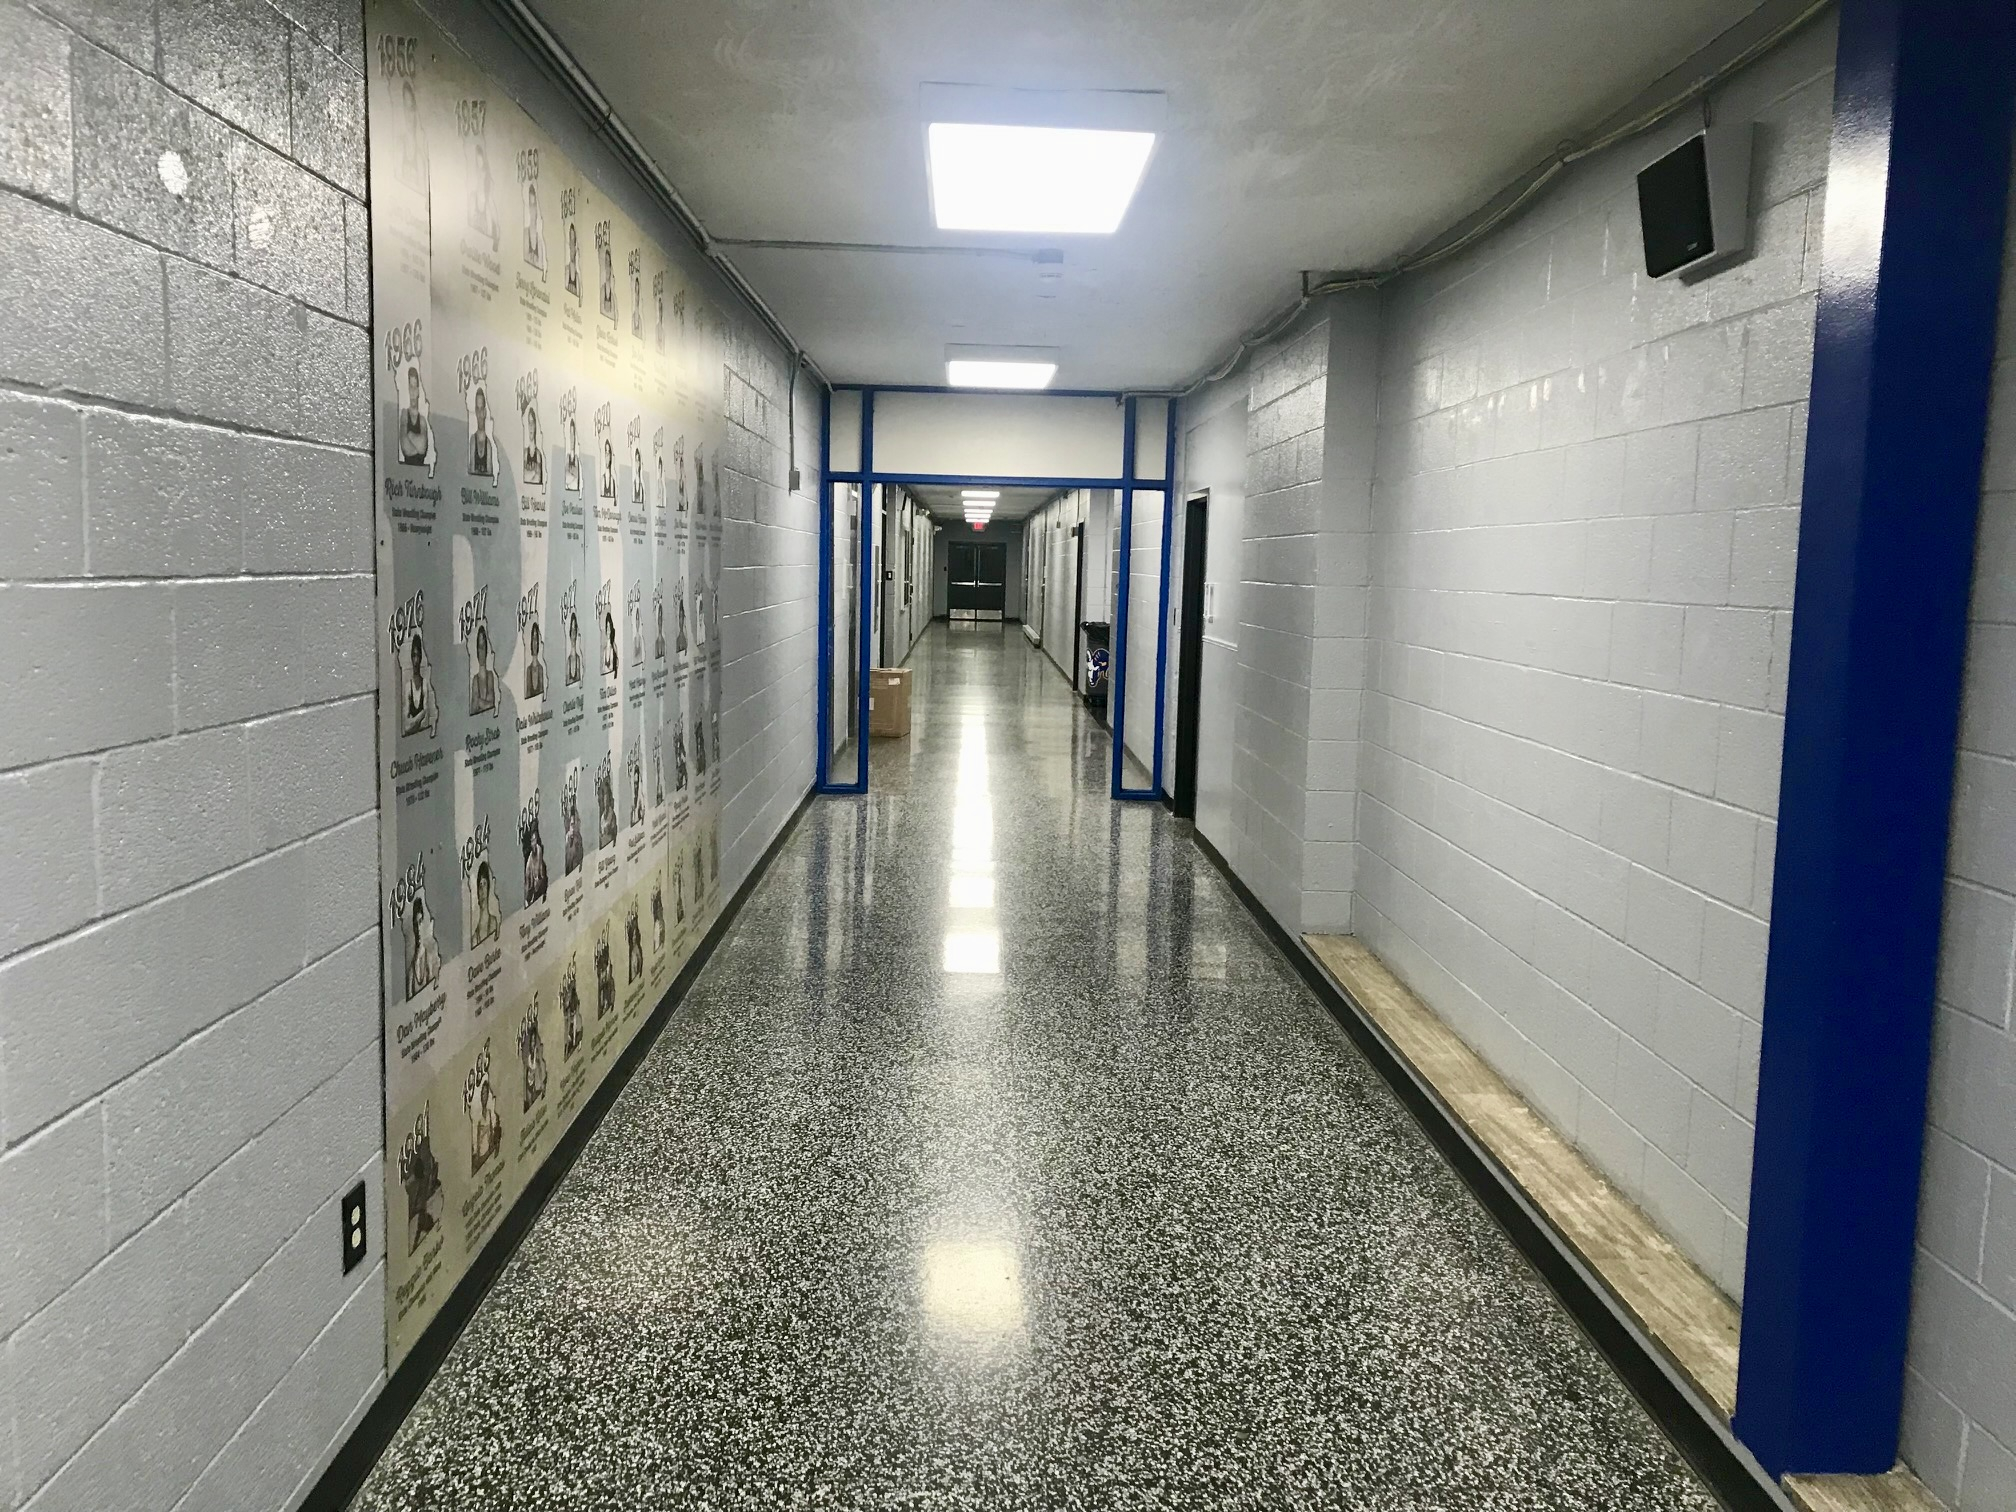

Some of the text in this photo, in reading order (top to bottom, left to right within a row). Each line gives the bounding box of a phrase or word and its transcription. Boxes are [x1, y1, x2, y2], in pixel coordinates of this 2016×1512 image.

[377, 34, 416, 79] 1956
[454, 99, 487, 137] 1957
[515, 148, 539, 182] 1959
[383, 318, 423, 371] 1966
[456, 346, 488, 393] 1966
[515, 367, 538, 411] 1969
[559, 385, 577, 425] 1969
[384, 477, 403, 500] Rich
[387, 589, 424, 654] 1976
[458, 584, 488, 643] 1977
[516, 581, 539, 632] 1977
[560, 578, 577, 624] 1977
[594, 578, 611, 621] 1977
[390, 755, 413, 779] Chuck
[459, 814, 490, 880] 1984
[388, 850, 425, 929] 1984
[396, 1021, 414, 1044] Dan
[461, 1037, 491, 1115] 1985
